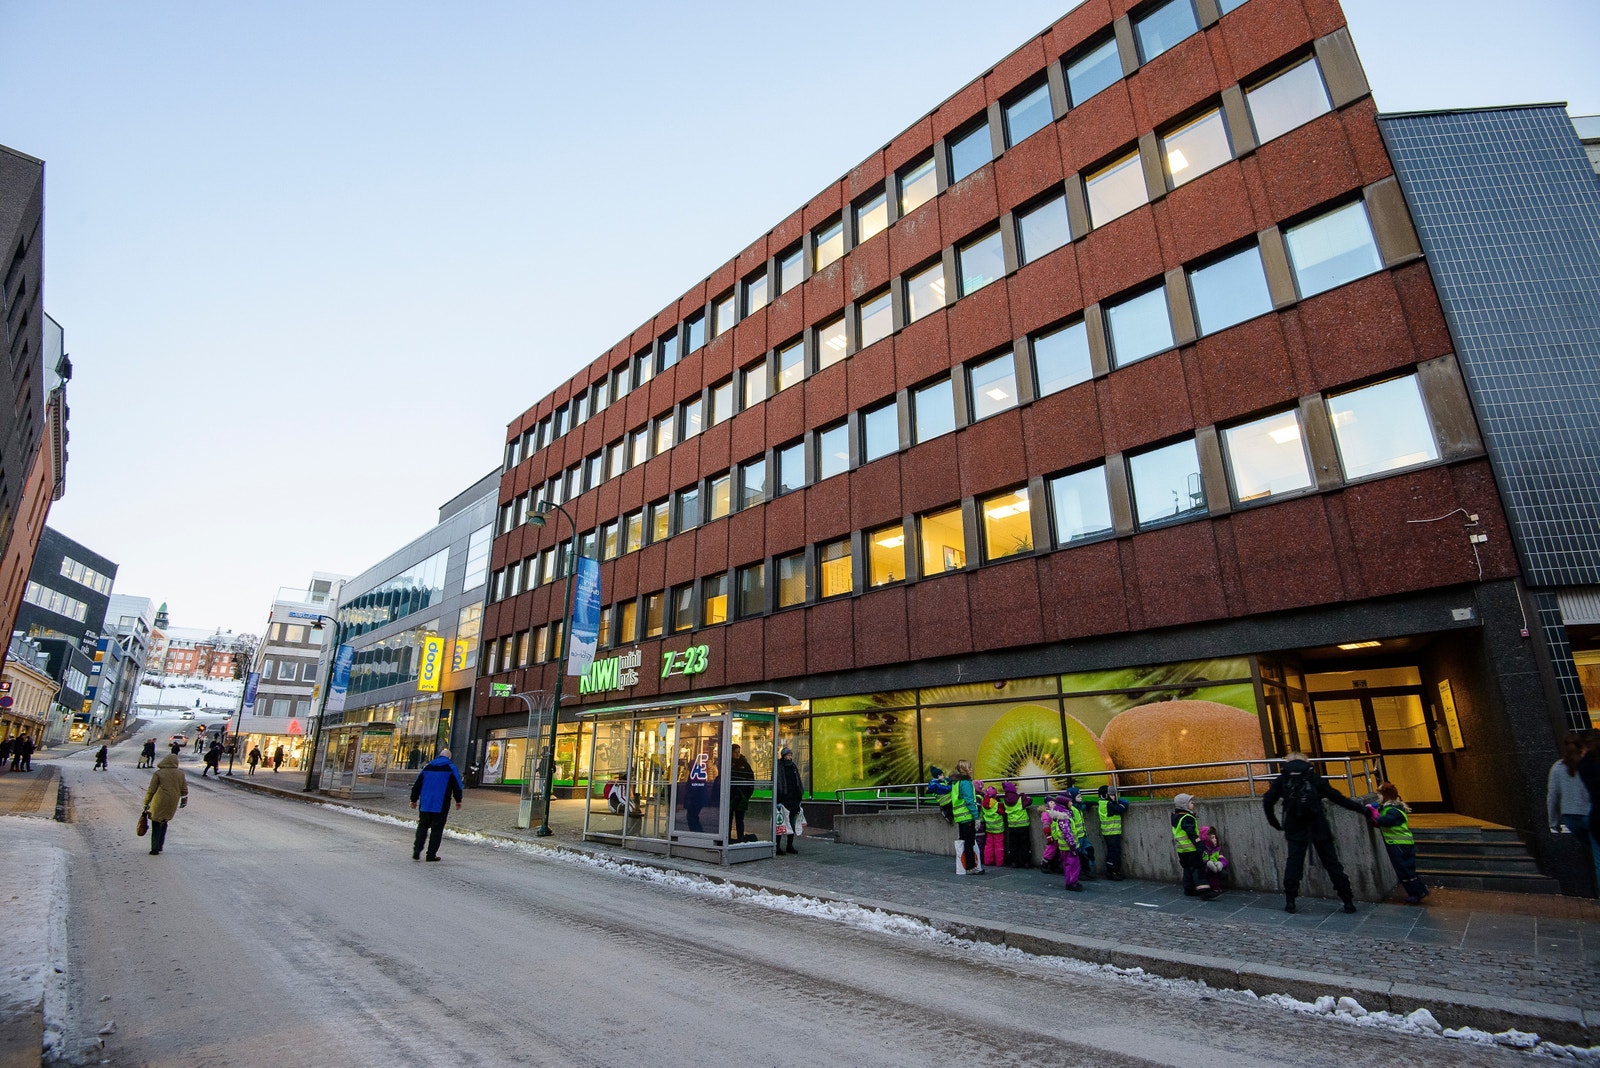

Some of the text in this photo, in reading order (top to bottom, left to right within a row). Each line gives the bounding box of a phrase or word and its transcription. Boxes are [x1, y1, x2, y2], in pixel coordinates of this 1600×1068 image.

[424, 642, 438, 680] coop
[619, 650, 641, 669] mini
[661, 644, 709, 678] 7-23
[618, 669, 639, 690] pris
